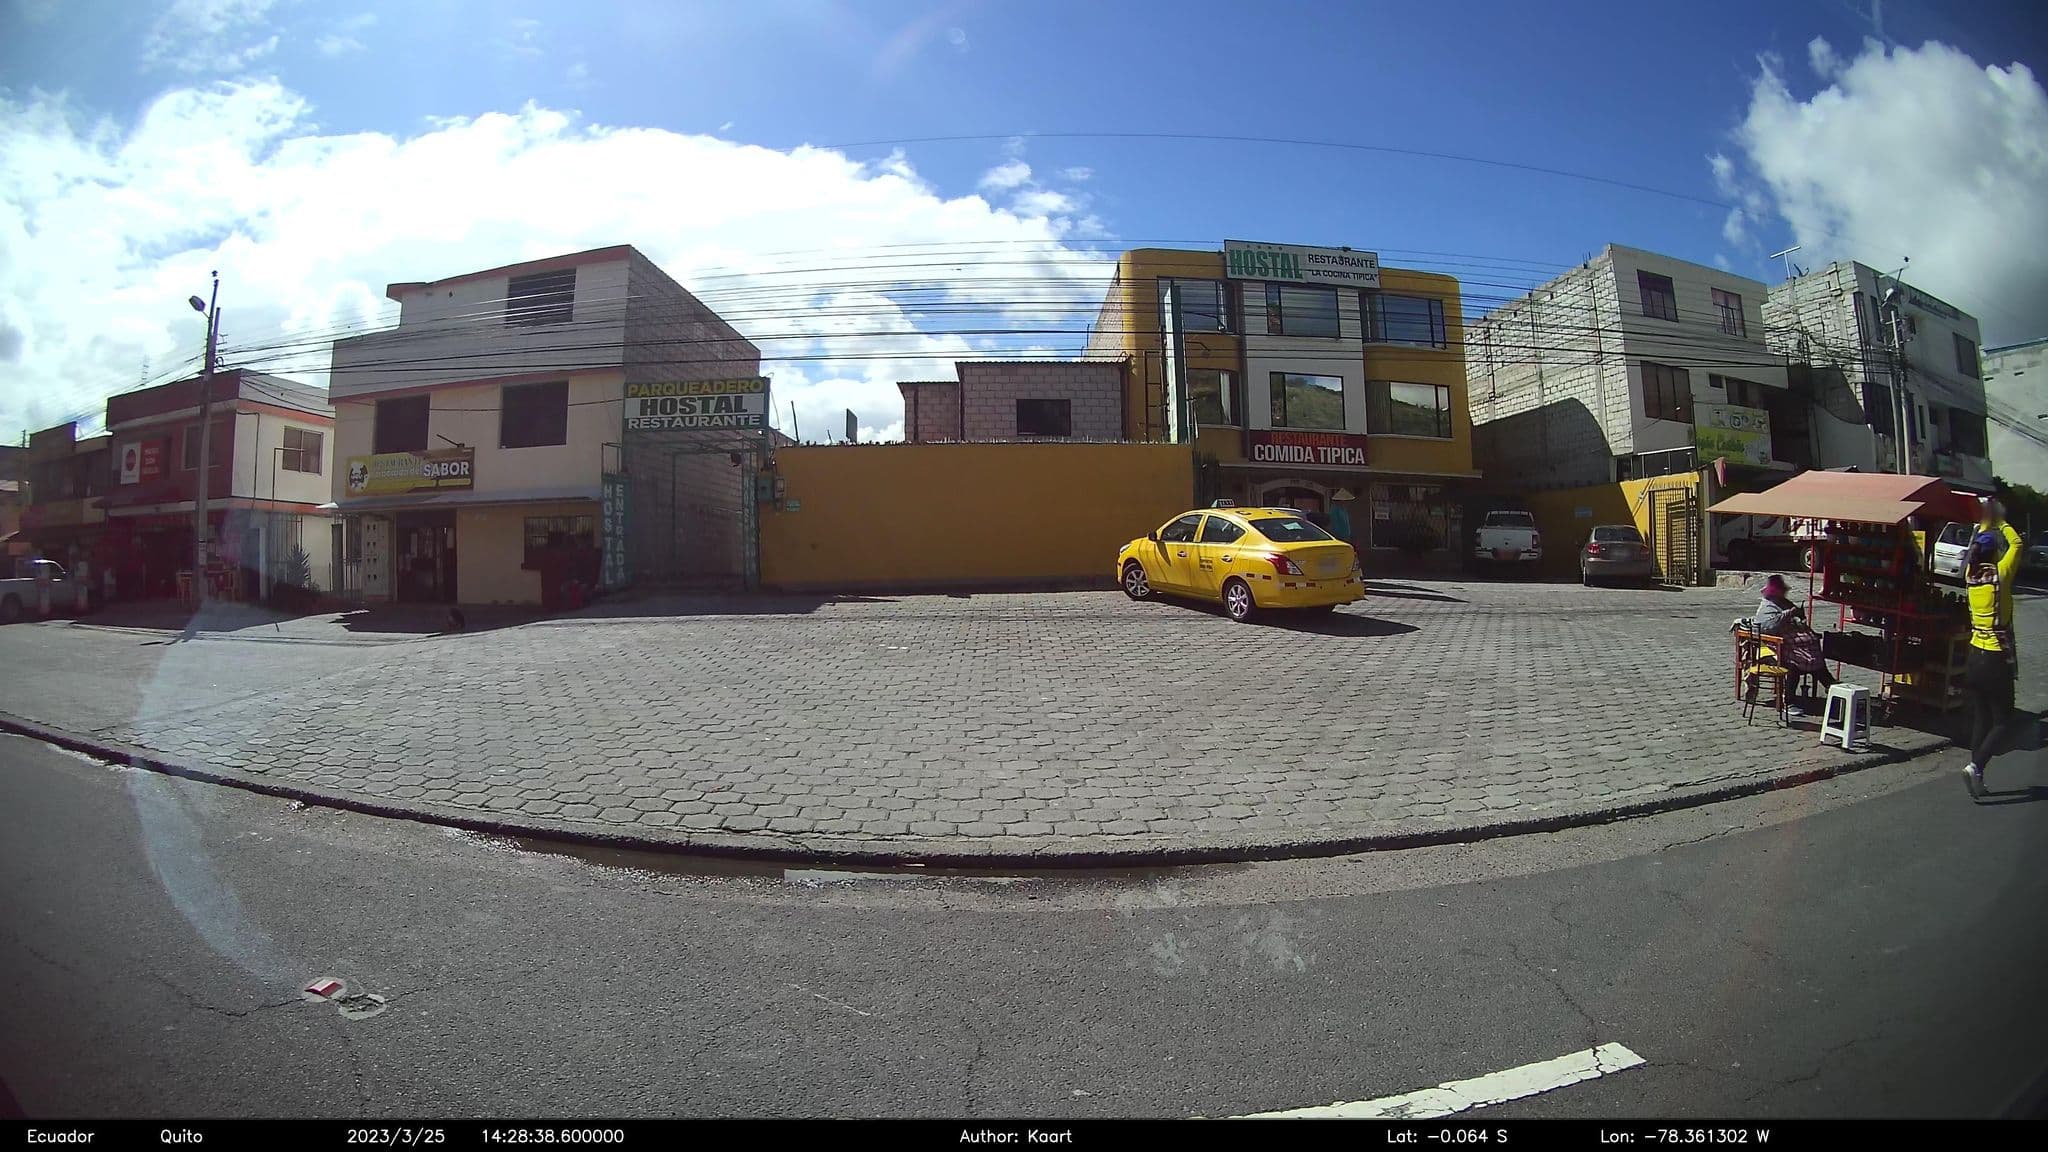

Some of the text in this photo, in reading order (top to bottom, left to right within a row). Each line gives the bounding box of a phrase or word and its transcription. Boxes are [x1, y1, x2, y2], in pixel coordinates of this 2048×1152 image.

[1229, 250, 1303, 279] HOSTAL
[1308, 254, 1375, 269] RESTAURANTE
[1323, 270, 1351, 279] COCINA
[628, 380, 763, 397] PARQUEADERO
[640, 395, 747, 416] HOSTAL
[628, 415, 761, 429] RESTAURANTE
[1271, 432, 1345, 446] RESTAURANTE
[1254, 444, 1365, 464] COMIDA TIPICA
[423, 462, 470, 477] SABOR
[603, 484, 614, 585] HOSTAL
[615, 484, 625, 583] ENTRADA
